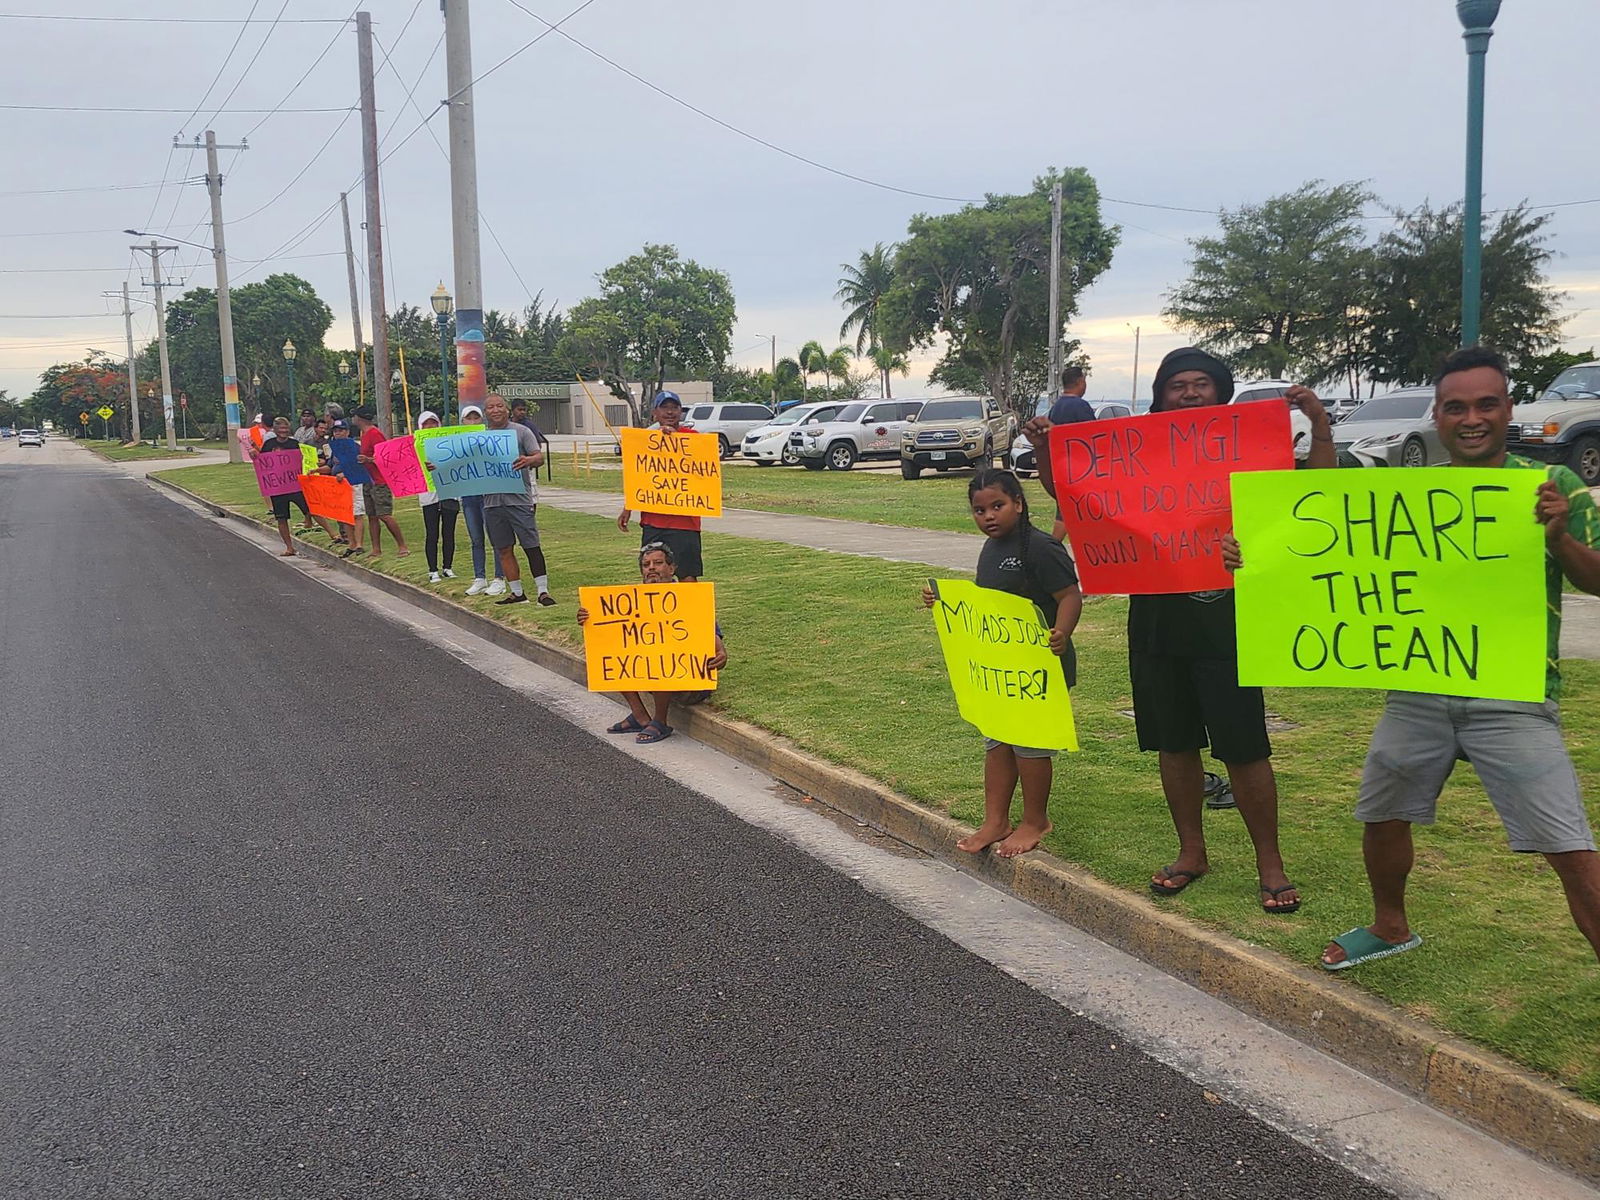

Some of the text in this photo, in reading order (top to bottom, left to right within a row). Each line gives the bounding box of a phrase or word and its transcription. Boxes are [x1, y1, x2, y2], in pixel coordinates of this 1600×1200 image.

[524, 387, 561, 396] MARKET
[436, 435, 511, 462] SUPPORT
[648, 433, 692, 457] SAVE
[1065, 415, 1242, 484] DEAR MGI
[259, 455, 275, 469] NO
[277, 454, 291, 466] TO
[438, 462, 484, 486] LOCAL
[636, 454, 719, 478] MANAGAHA
[262, 472, 286, 490] NEW
[652, 475, 689, 492] SAVE
[635, 488, 715, 511] GHALGHAL
[1069, 477, 1233, 522] YOU DO NO
[1286, 485, 1510, 562] SHARE
[1083, 526, 1233, 567] OWN MANA
[600, 588, 677, 618] NO! TO
[1311, 570, 1425, 616] THE
[622, 619, 689, 649] MGI'S
[941, 600, 975, 634] MY
[1013, 617, 1052, 648] JOB
[1292, 621, 1479, 681] OCEAN
[969, 659, 1048, 701] MATTERS!
